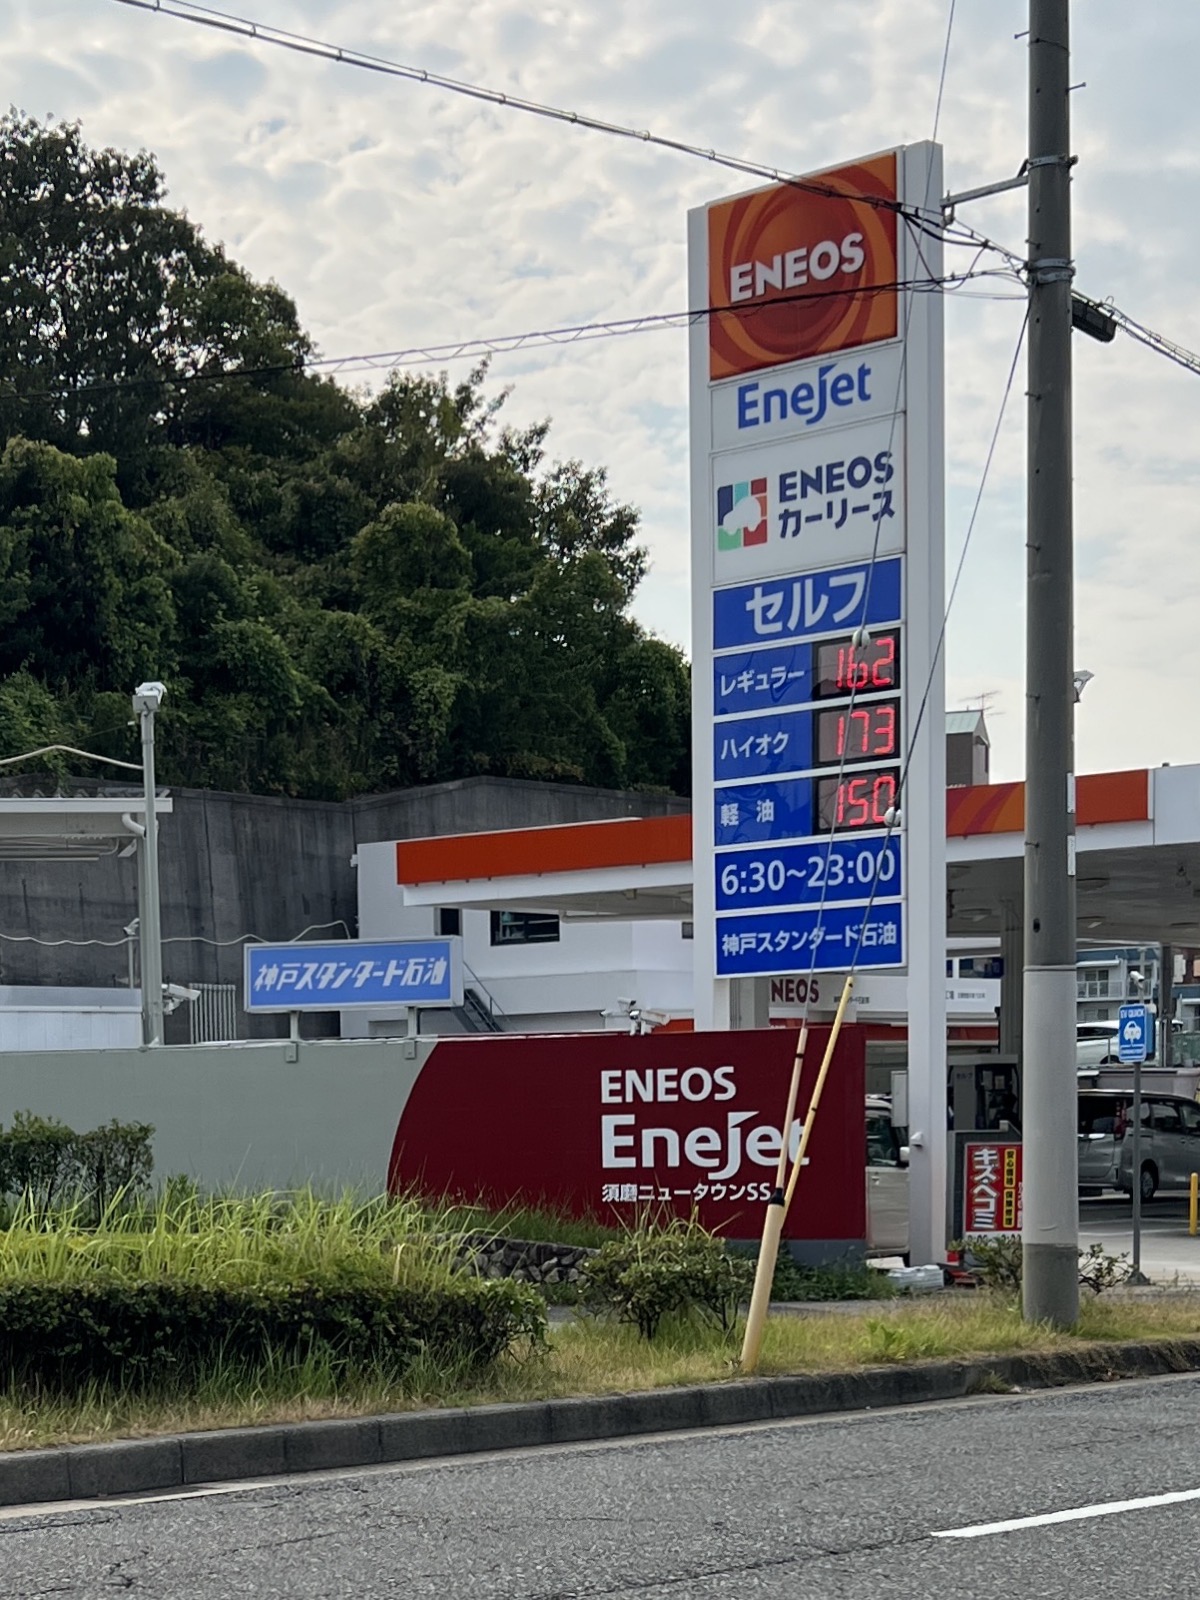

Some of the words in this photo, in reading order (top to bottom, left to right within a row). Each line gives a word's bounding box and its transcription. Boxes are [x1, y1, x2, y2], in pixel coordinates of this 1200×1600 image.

[730, 232, 864, 303] ENEOS
[778, 451, 894, 502] ENEOS
[778, 489, 895, 539] カーリース
[746, 571, 866, 635] セルフ
[720, 666, 804, 697] レギュラー
[836, 637, 895, 688] 162
[720, 731, 789, 760] ハイオク
[836, 706, 895, 756] 173
[836, 775, 896, 826] 150
[721, 921, 897, 957] 神戸スタンダード石油
[253, 956, 448, 991] 神戸スタンダード石油
[771, 978, 820, 1003] NEOS
[601, 1066, 737, 1103] ENEOS
